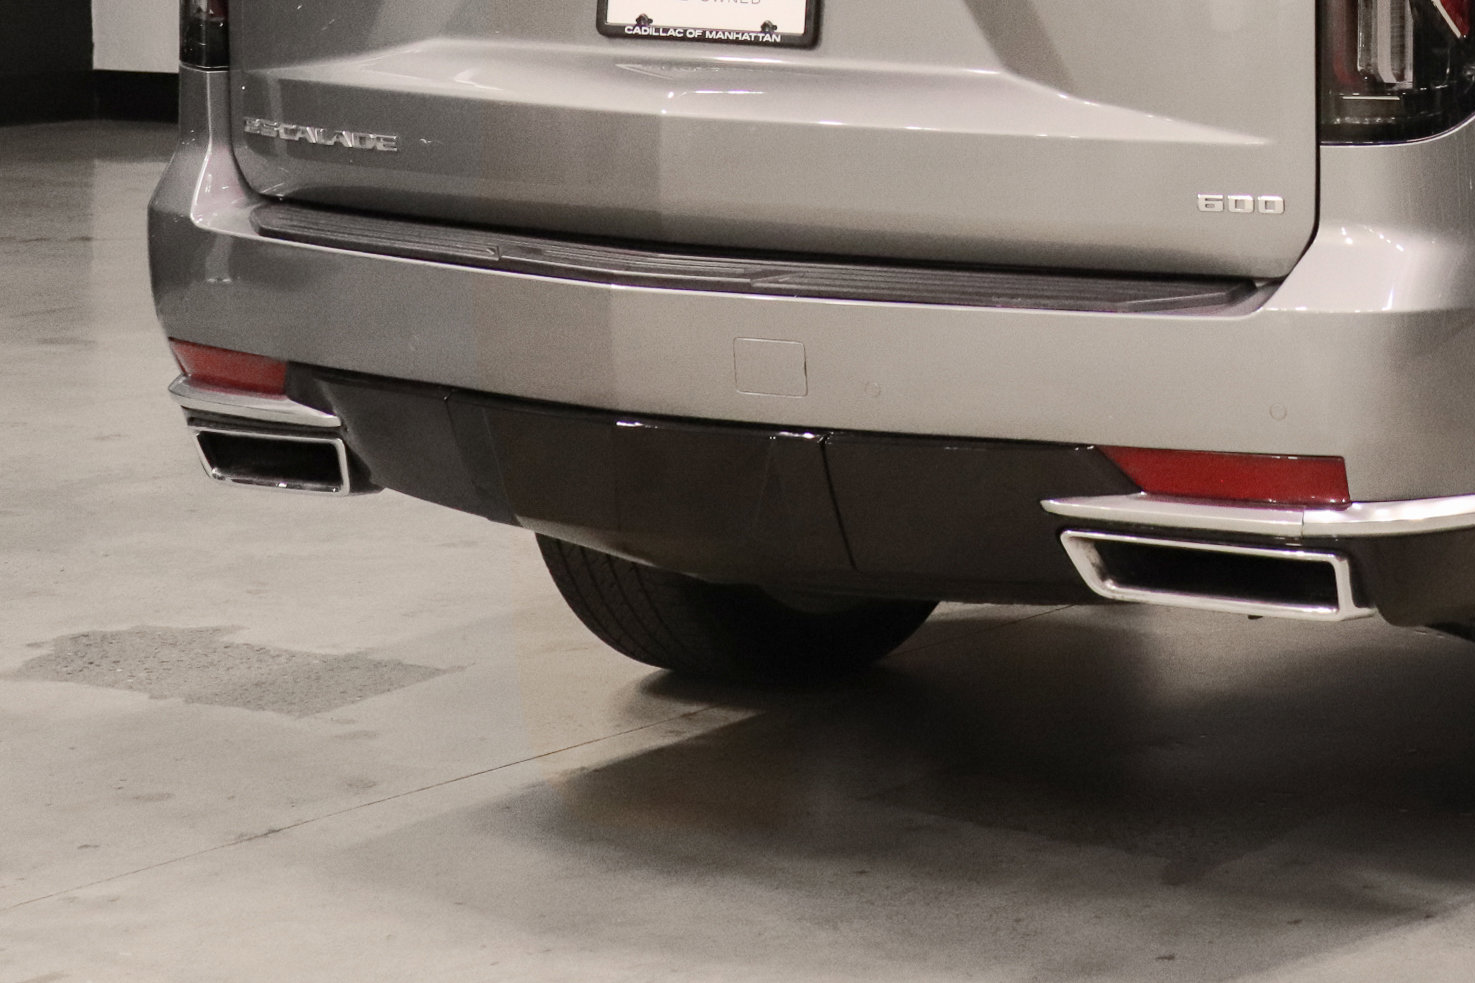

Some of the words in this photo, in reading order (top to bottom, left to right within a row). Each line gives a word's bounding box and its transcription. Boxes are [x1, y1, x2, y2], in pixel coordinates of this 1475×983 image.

[625, 25, 684, 37] CADILLAC
[686, 28, 702, 38] OF
[705, 30, 781, 43] MANHATTAN
[244, 117, 398, 152] ESCALADE
[1197, 193, 1285, 214] 600
